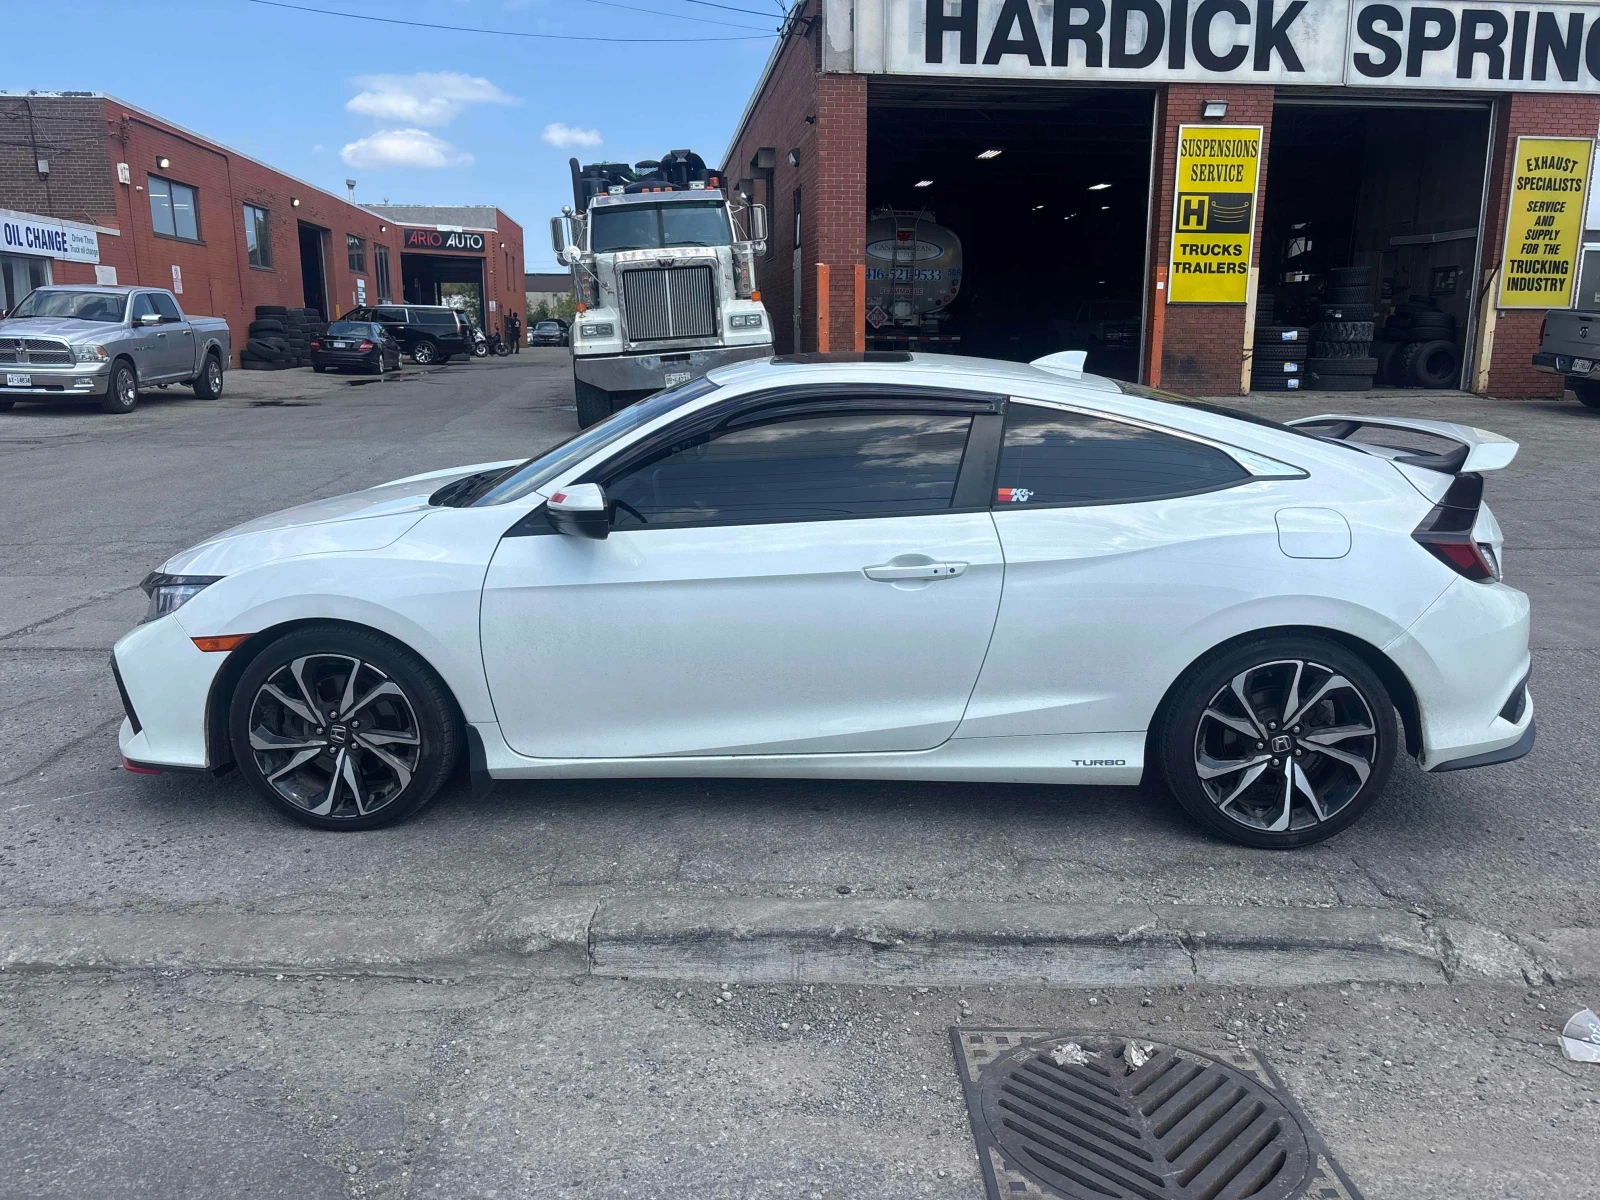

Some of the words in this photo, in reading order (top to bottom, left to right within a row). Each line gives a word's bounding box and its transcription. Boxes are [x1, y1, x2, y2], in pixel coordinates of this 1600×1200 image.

[925, 0, 1305, 72] HARDICK
[1181, 138, 1258, 158] SUSPENSIONS
[1526, 155, 1578, 174] EXHAUST
[1190, 163, 1244, 182] SERVICE
[1516, 176, 1582, 193] SPECIALISTS
[1182, 199, 1206, 227] H
[1526, 200, 1566, 213] SERVICE
[1534, 215, 1555, 227] AND
[3, 222, 24, 247] OIL
[25, 226, 68, 253] CHANGE
[71, 233, 84, 244] Drive
[84, 235, 95, 245] Thru
[408, 230, 443, 247] ARIO
[445, 233, 483, 249] AUTO
[1525, 228, 1560, 241] SUPPLY
[69, 244, 81, 254] Truck
[86, 248, 99, 258] change
[1180, 243, 1242, 256] TRUCKS
[1520, 243, 1539, 255] FOR
[1543, 243, 1561, 255] THE
[866, 266, 942, 281] 416-521-9533
[1173, 261, 1247, 275] TRAILERS
[1509, 259, 1569, 275] TRUCKING
[880, 287, 924, 296] FLAMMABLE
[1506, 277, 1567, 292] INDUSTRY
